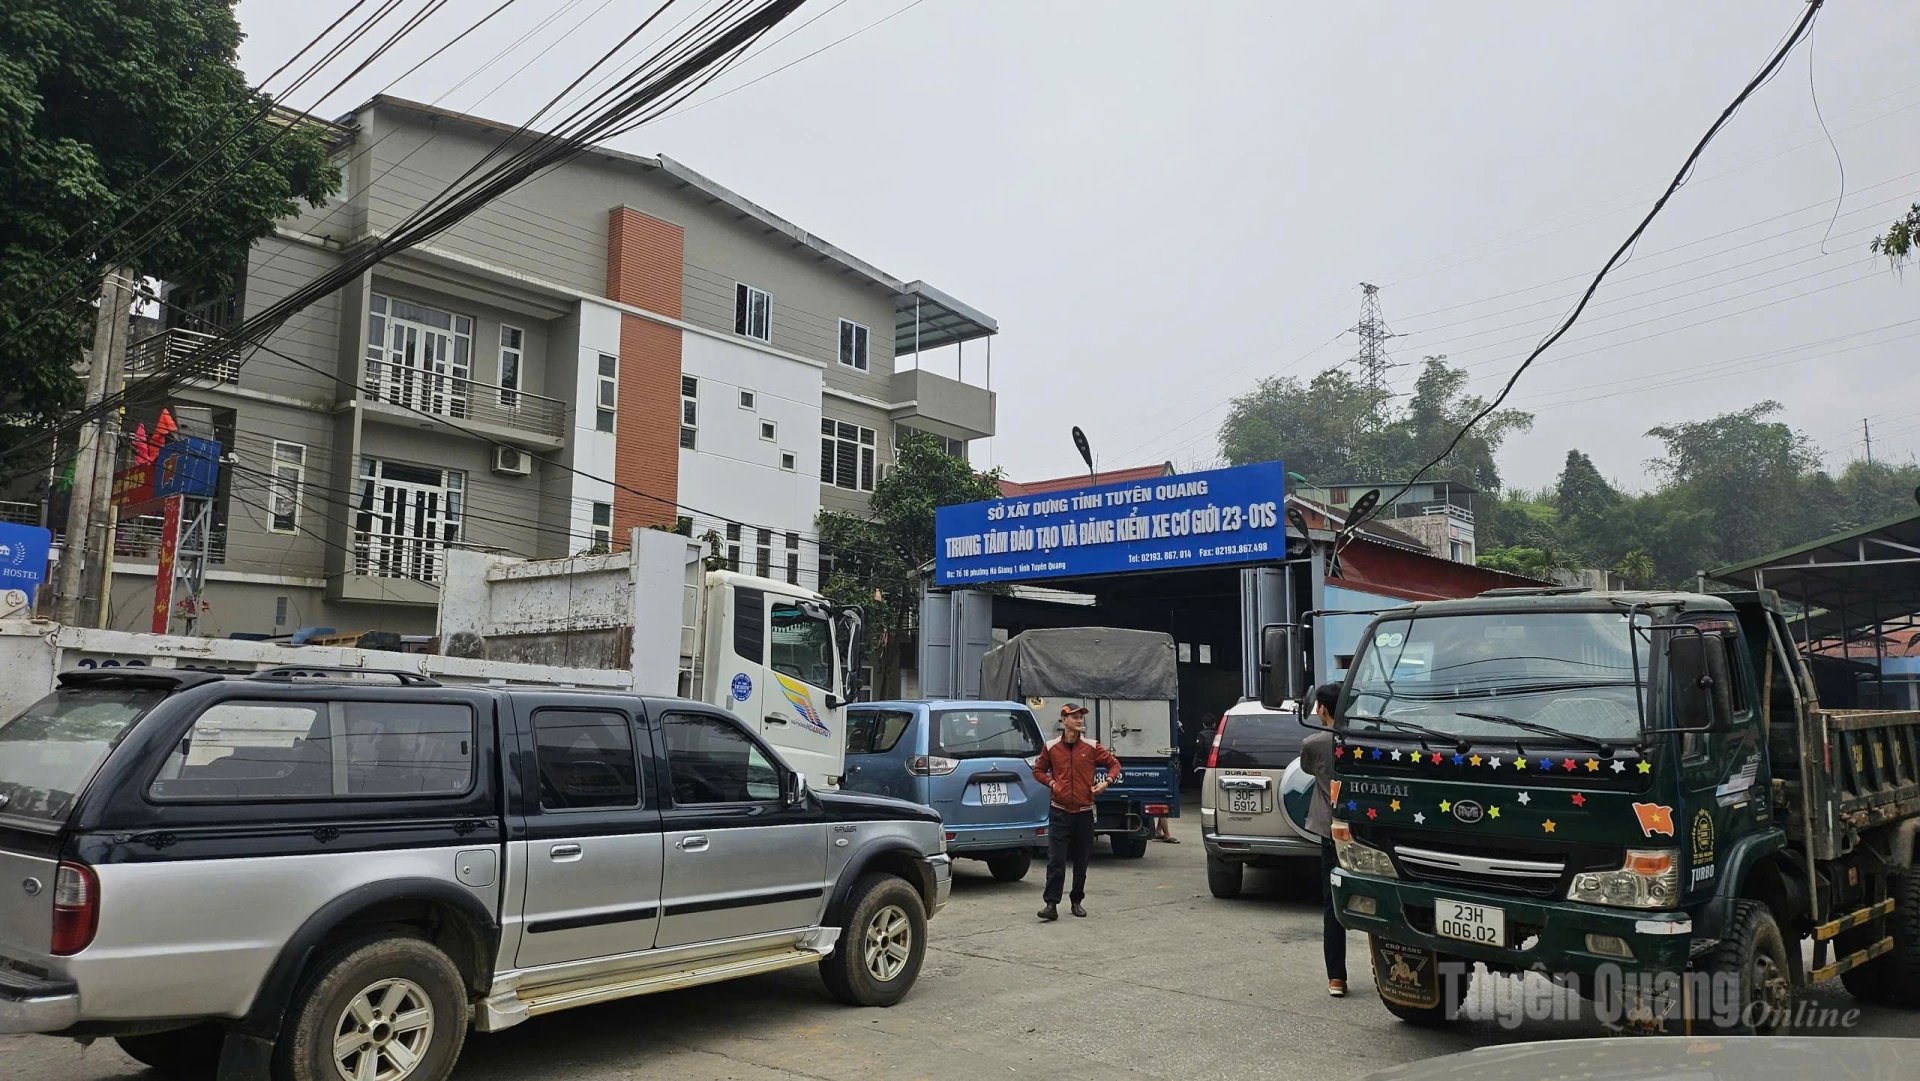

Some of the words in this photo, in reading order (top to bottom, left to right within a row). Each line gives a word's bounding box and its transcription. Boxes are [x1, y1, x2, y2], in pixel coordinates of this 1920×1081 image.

[988, 502, 1004, 521] SỞ
[1007, 501, 1031, 519] XÂY
[1033, 499, 1068, 518] DỰNG
[1071, 491, 1102, 511] TỈNH
[1105, 485, 1152, 506] TUYÊN
[1156, 480, 1208, 501] QUANG
[945, 534, 981, 558] TRUNG
[983, 528, 1008, 554] TÂM
[1010, 525, 1034, 552] ĐÀO
[1036, 525, 1059, 554] TẠO
[1061, 519, 1078, 547] VÀ
[1079, 517, 1115, 545] ĐĂNG
[1116, 506, 1149, 542] KIỂM
[1151, 513, 1170, 538] XE
[1171, 508, 1191, 536] CƠ
[1192, 502, 1220, 535] GIỚI
[1128, 554, 1140, 563] Tel:
[1179, 550, 1191, 559] 014
[1199, 547, 1214, 557] Fax:
[3, 568, 39, 580] HOSTEL
[998, 564, 1013, 576] Giang
[1031, 562, 1047, 574] Tuyên
[1048, 561, 1066, 572] Quang
[986, 783, 1001, 793] 23A
[1235, 790, 1255, 801] 30F
[1350, 782, 1409, 797] HOAMAI
[1234, 801, 1257, 812] 5912
[1690, 864, 1714, 892] TURBO
[1454, 905, 1483, 923] 23H
[1442, 920, 1496, 943] 006.02
